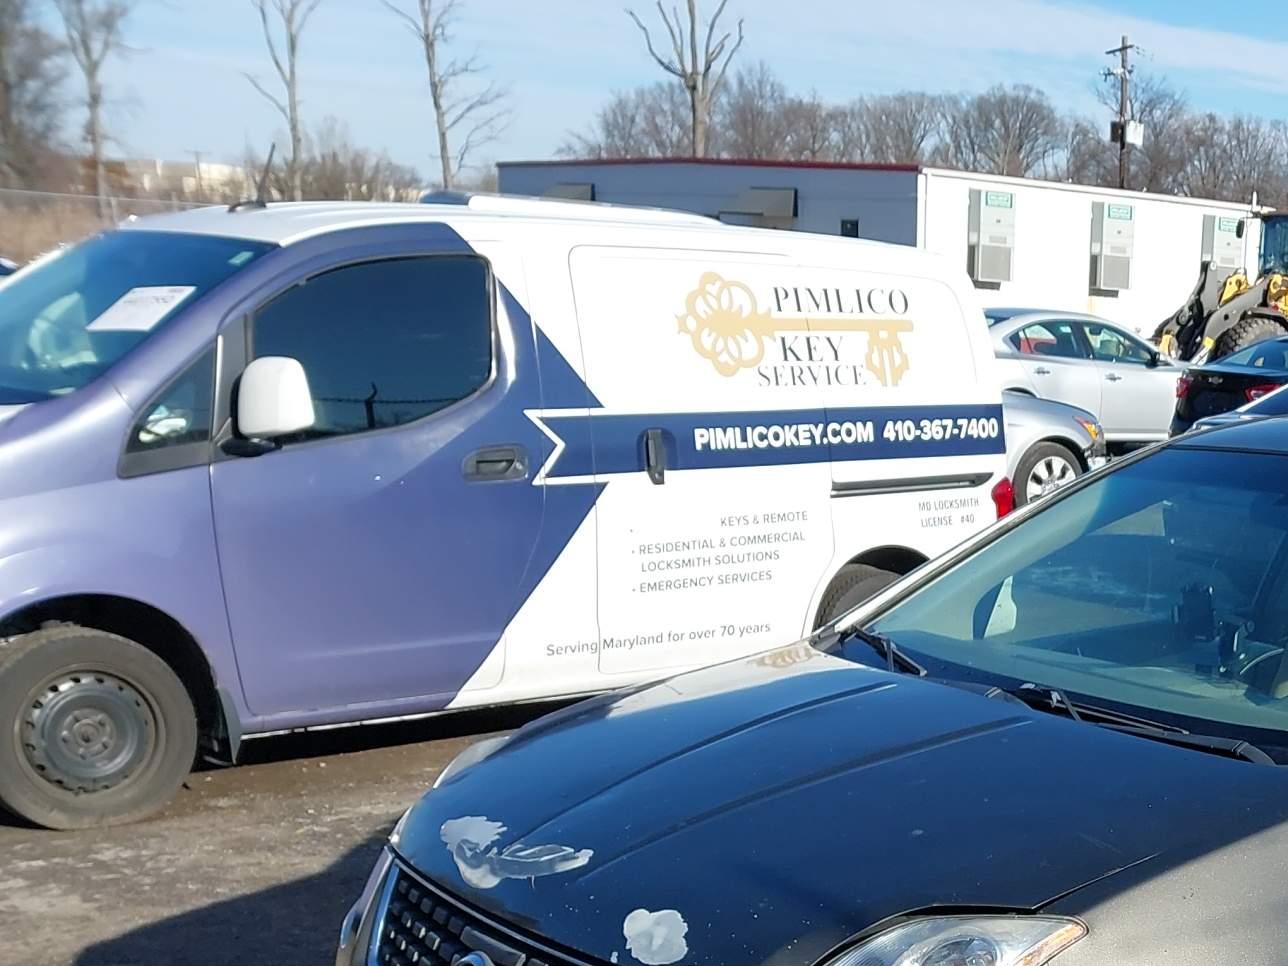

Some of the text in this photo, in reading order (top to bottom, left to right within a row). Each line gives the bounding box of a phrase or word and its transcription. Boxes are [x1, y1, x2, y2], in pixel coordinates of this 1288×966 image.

[773, 286, 909, 315] PIMLICO
[780, 336, 844, 362] KEY
[757, 364, 867, 387] SERVICE
[693, 418, 998, 450] PIMLICOKEY.COM 410-367-7400
[934, 497, 979, 511] LOCKSMITH
[720, 510, 808, 527] KEYS & REMOTE
[921, 513, 975, 528] LICENSE #40
[639, 531, 806, 556] RESIDENTIAL & COMMERCIAL
[641, 550, 780, 573] LOCKSMITH SOLUTIONS
[639, 570, 773, 593] EMERGENCY SERVICES
[546, 622, 771, 657] Serving Maryland for over 70 years
